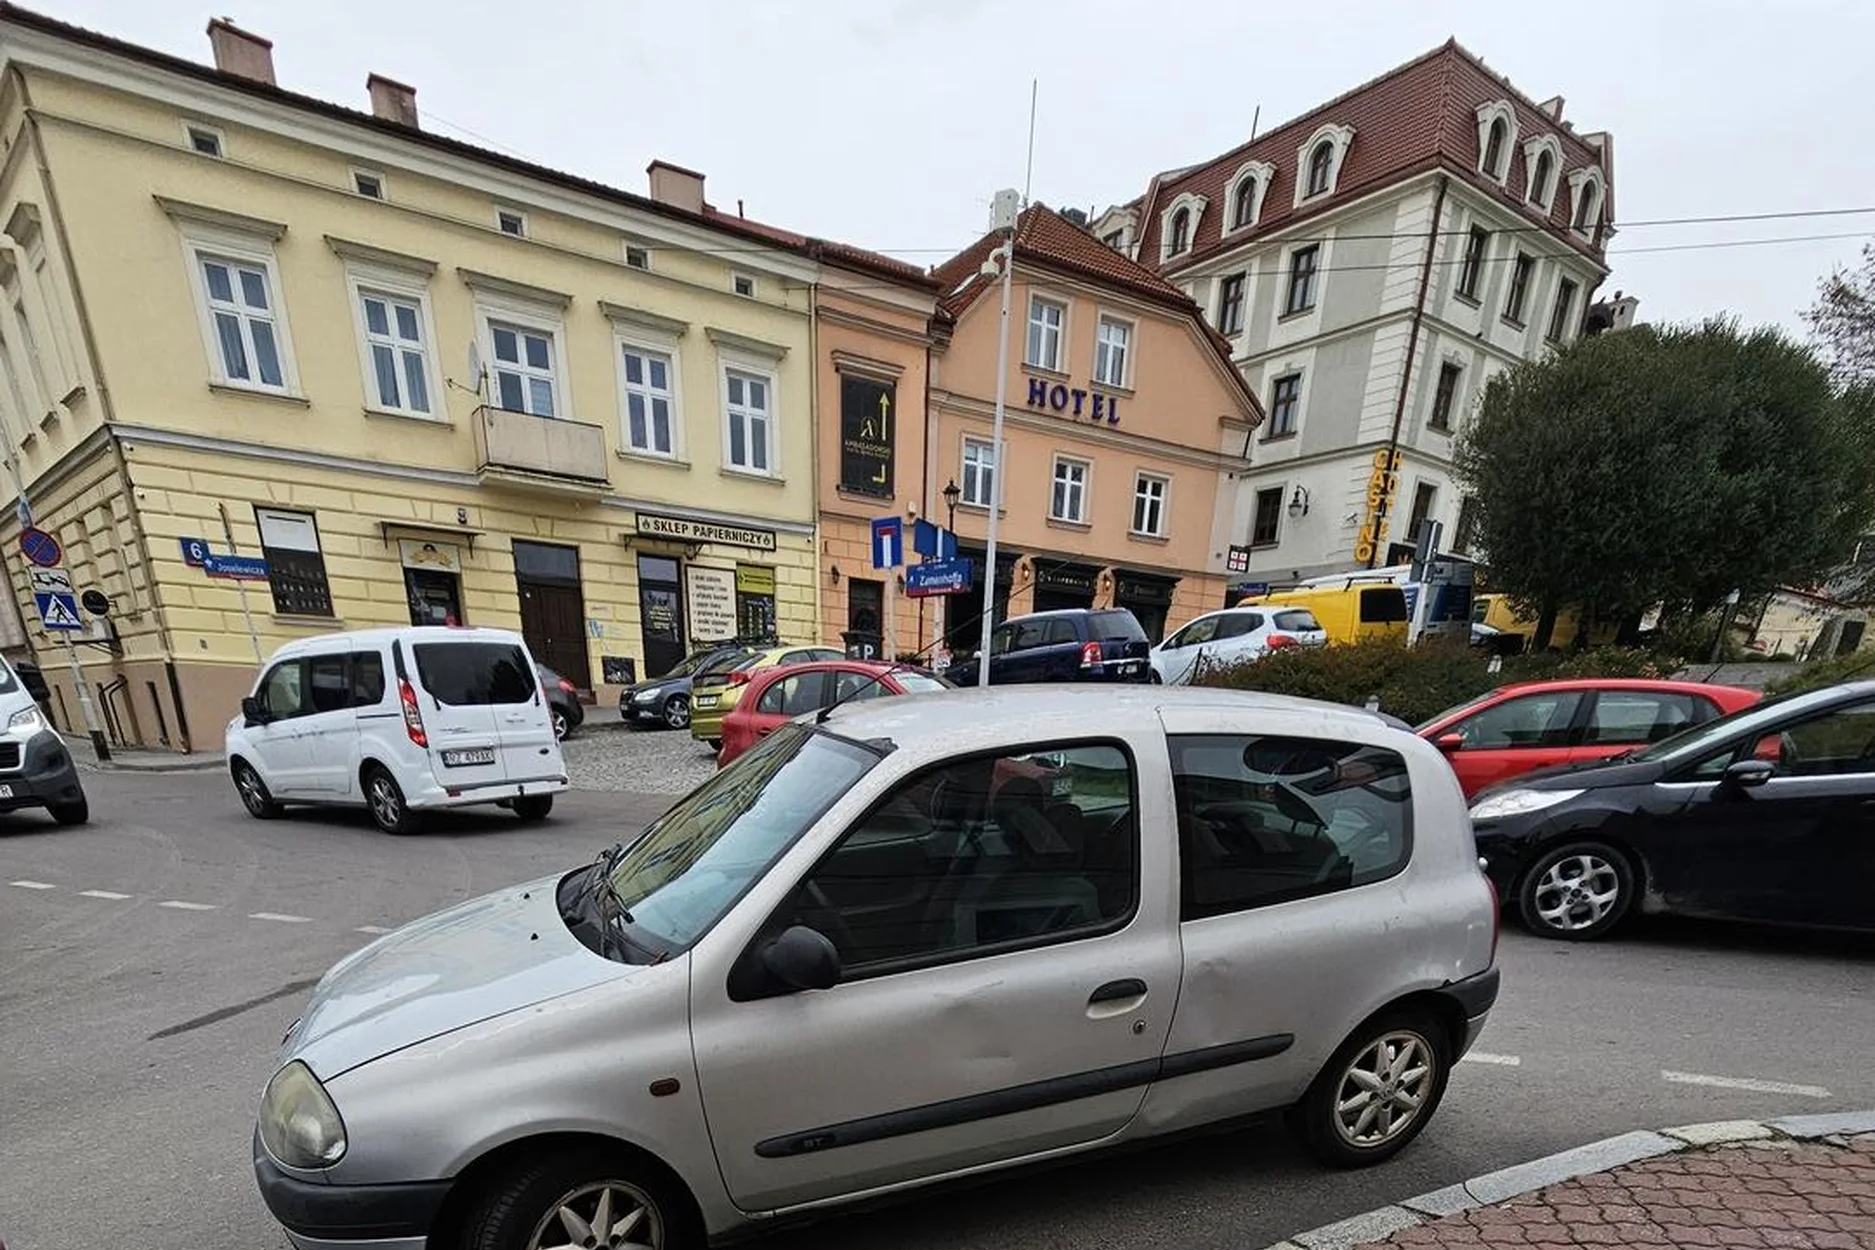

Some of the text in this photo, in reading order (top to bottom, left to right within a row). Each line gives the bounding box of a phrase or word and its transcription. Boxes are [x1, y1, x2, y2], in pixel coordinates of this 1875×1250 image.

[1027, 378, 1121, 424] HOTEL
[1355, 450, 1391, 564] CASINO
[653, 519, 762, 545] SKLEP PAPIERNICZY
[190, 542, 203, 559] 6
